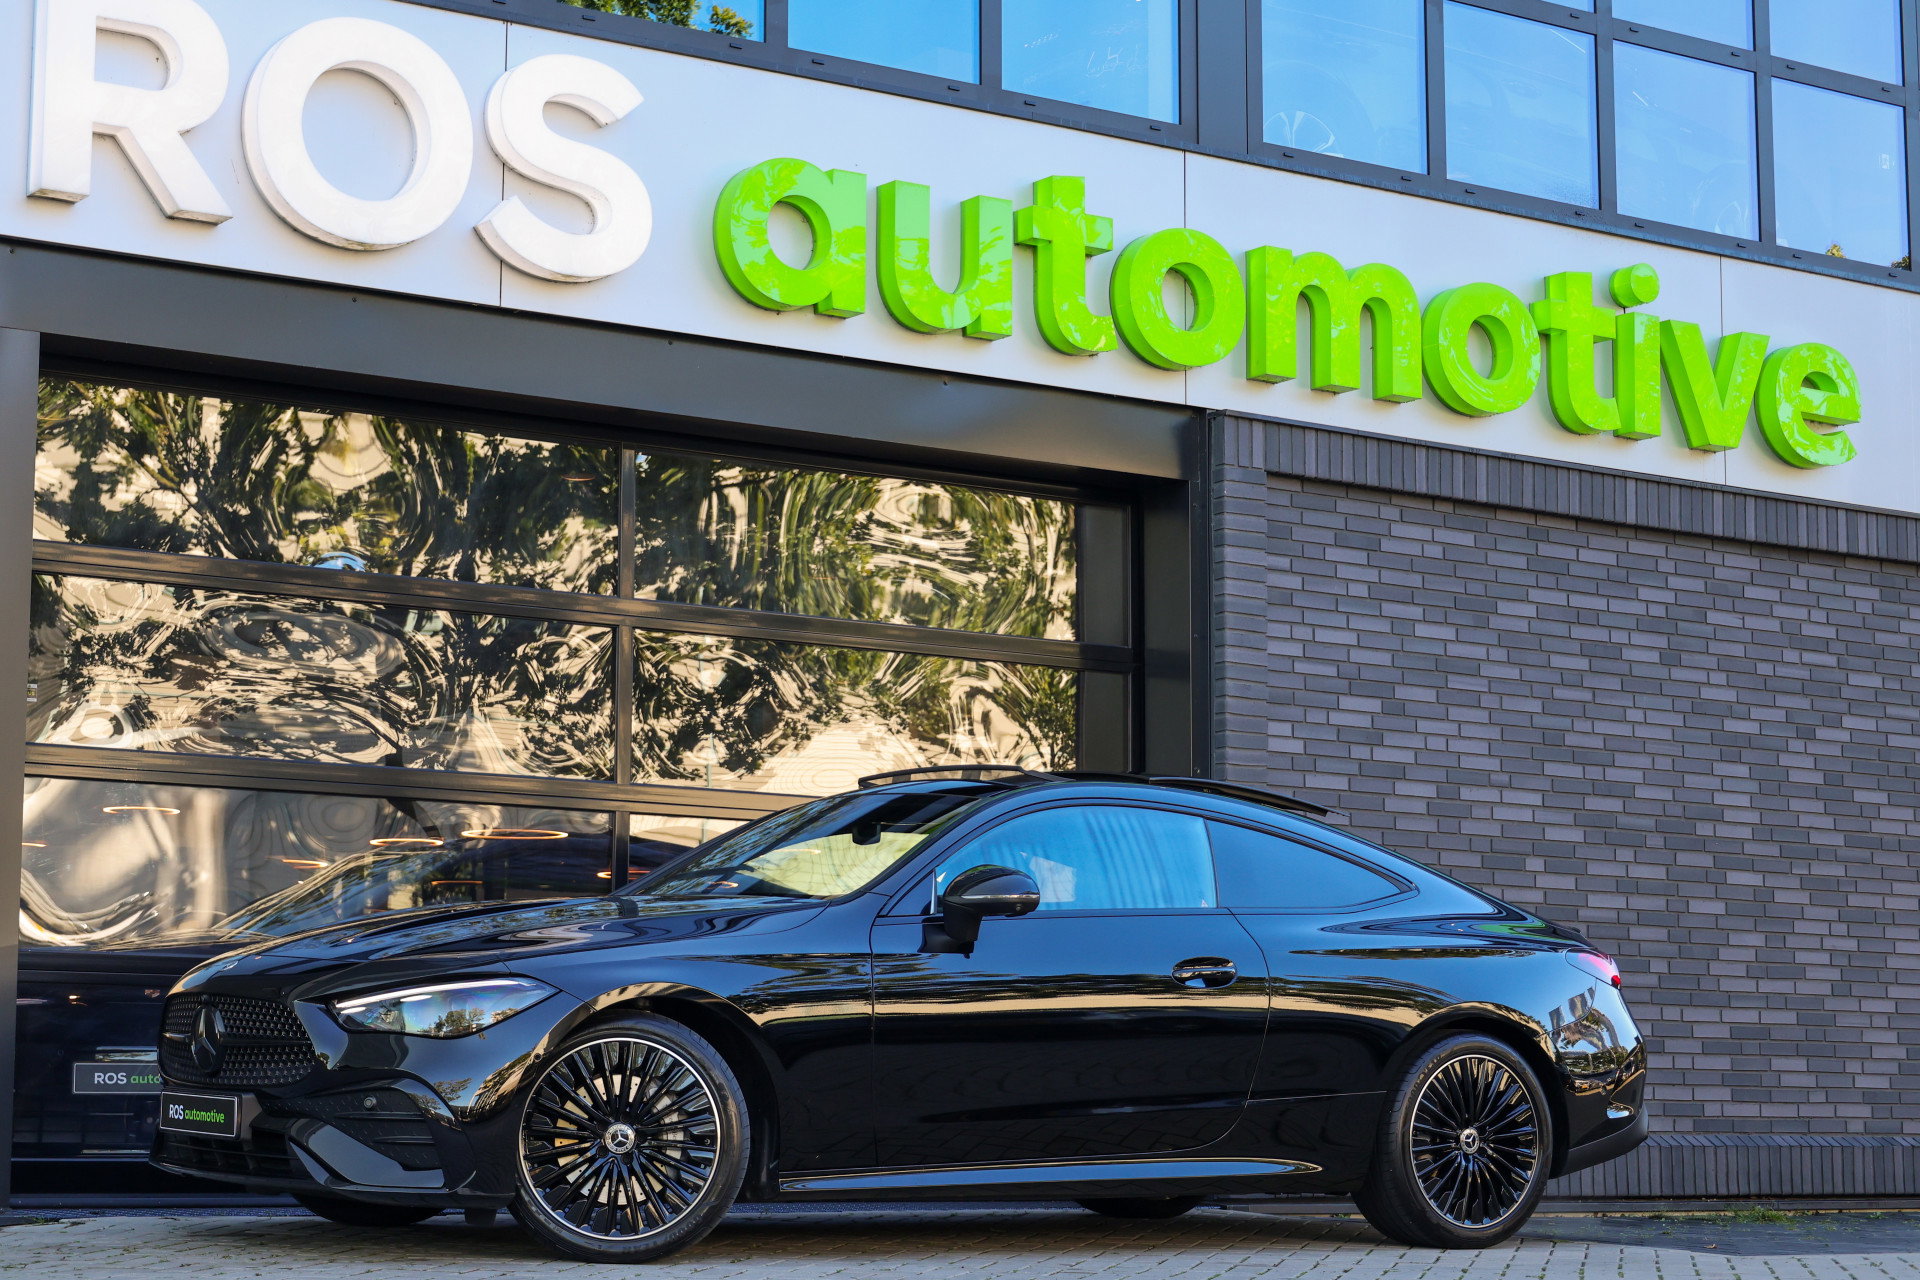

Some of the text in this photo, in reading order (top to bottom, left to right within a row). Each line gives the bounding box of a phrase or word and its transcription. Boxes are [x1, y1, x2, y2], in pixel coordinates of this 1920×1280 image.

[27, 0, 1861, 469] ROS automotive
[94, 1072, 127, 1085] ROS
[169, 1104, 225, 1123] ROS automotive
